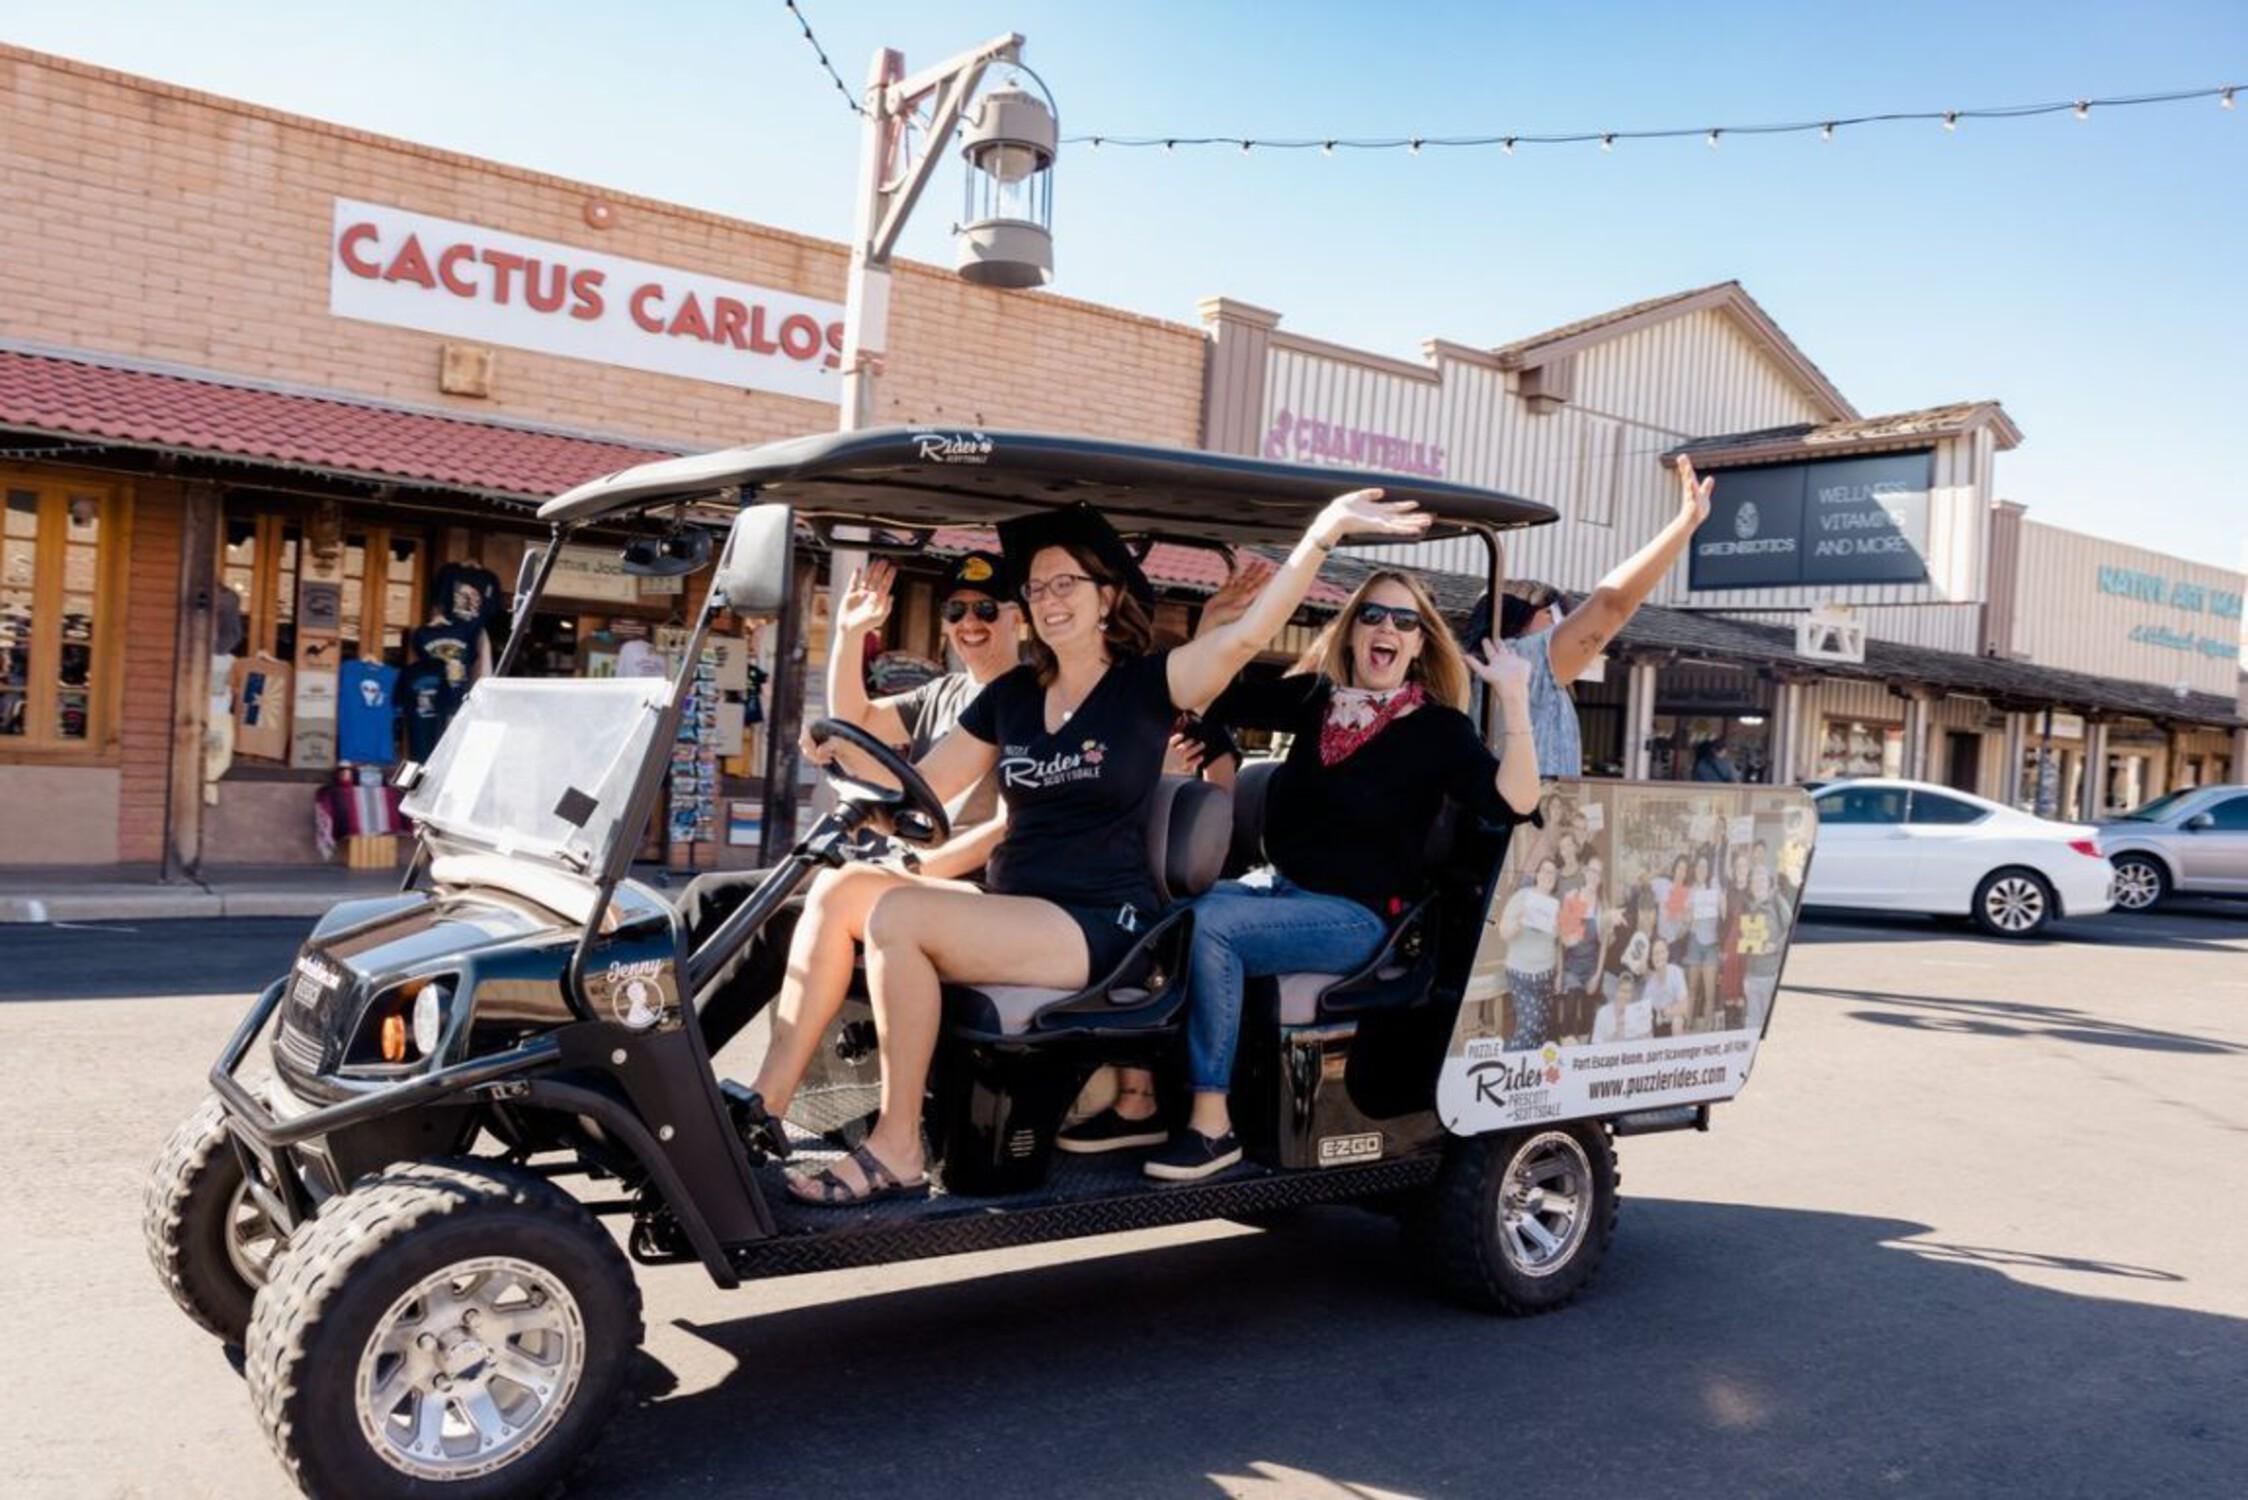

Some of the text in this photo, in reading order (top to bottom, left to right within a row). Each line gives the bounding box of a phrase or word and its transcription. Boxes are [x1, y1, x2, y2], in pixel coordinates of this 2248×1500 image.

[338, 222, 846, 368] CACTUS CARLOS
[1816, 535, 1907, 556] AND MORE
[1000, 752, 1081, 788] Rides
[606, 958, 664, 983] Jenny
[1466, 1057, 1542, 1108] Rides
[1589, 1066, 1726, 1099] www.puzzlerides.com
[1322, 1137, 1379, 1157] EZGO
